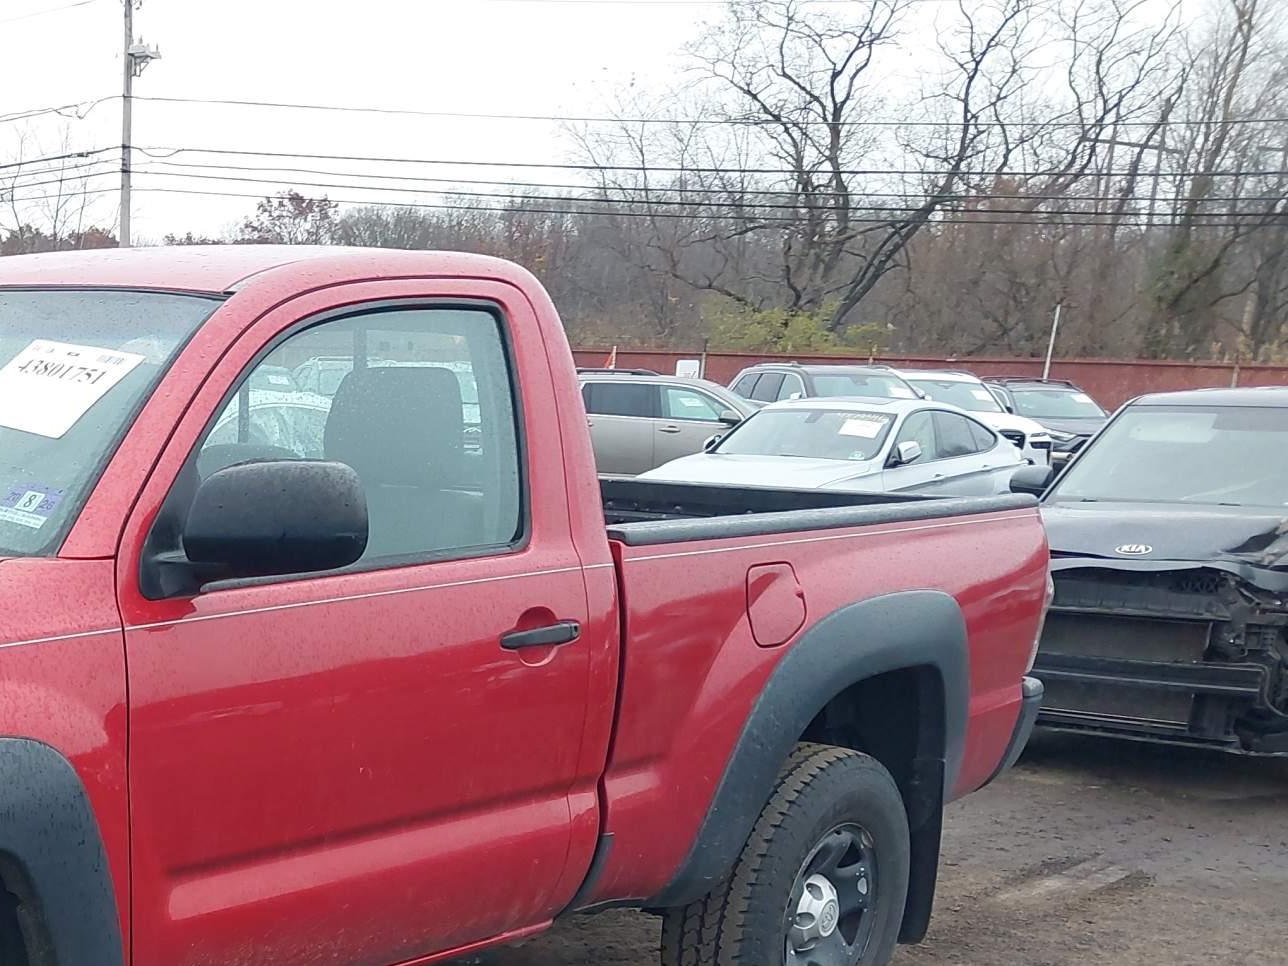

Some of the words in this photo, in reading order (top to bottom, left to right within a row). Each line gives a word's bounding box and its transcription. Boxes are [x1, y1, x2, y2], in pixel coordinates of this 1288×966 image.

[18, 359, 107, 385] 43801751
[23, 494, 37, 508] 8
[1119, 543, 1148, 554] KIA
